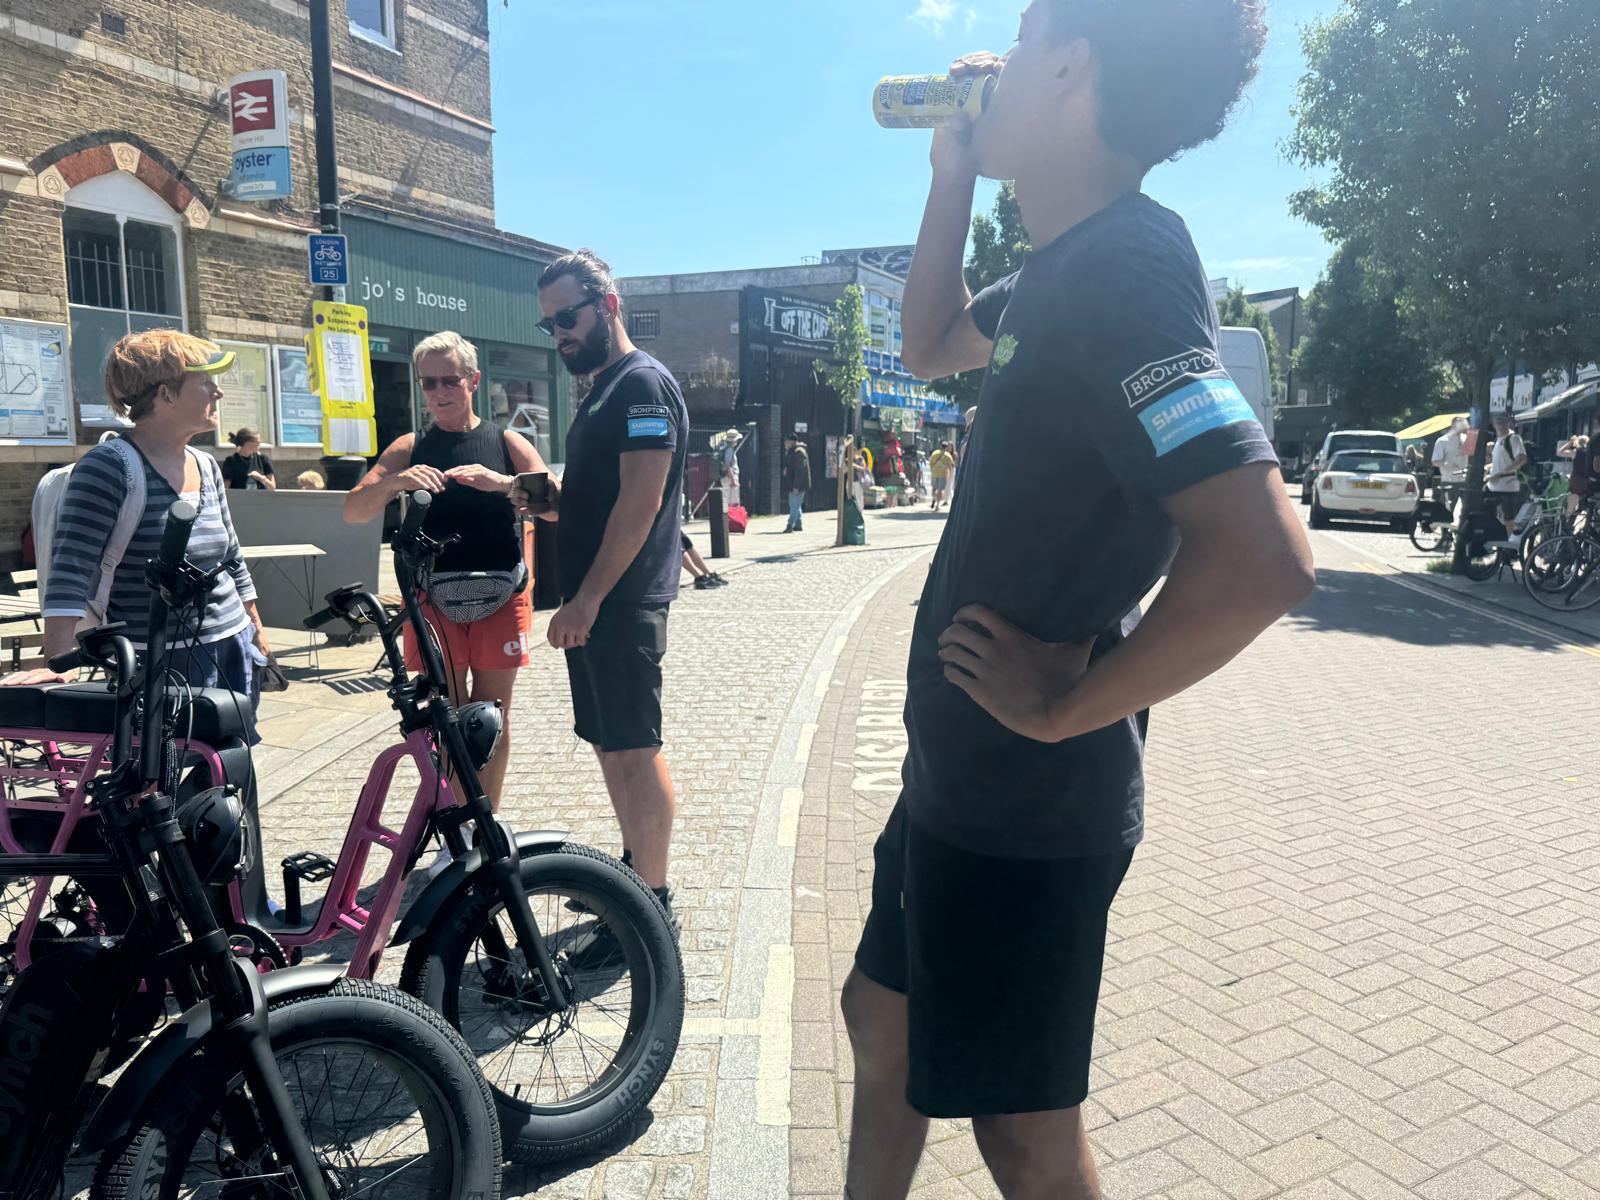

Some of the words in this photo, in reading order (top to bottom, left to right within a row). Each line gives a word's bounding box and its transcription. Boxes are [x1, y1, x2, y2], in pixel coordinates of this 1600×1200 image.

[234, 152, 272, 173] oyster
[323, 270, 336, 278] 25
[361, 276, 405, 302] jo's
[416, 286, 467, 312] house
[781, 309, 796, 333] OFF
[797, 310, 812, 339] THE
[613, 1039, 665, 1107] SYNCH
